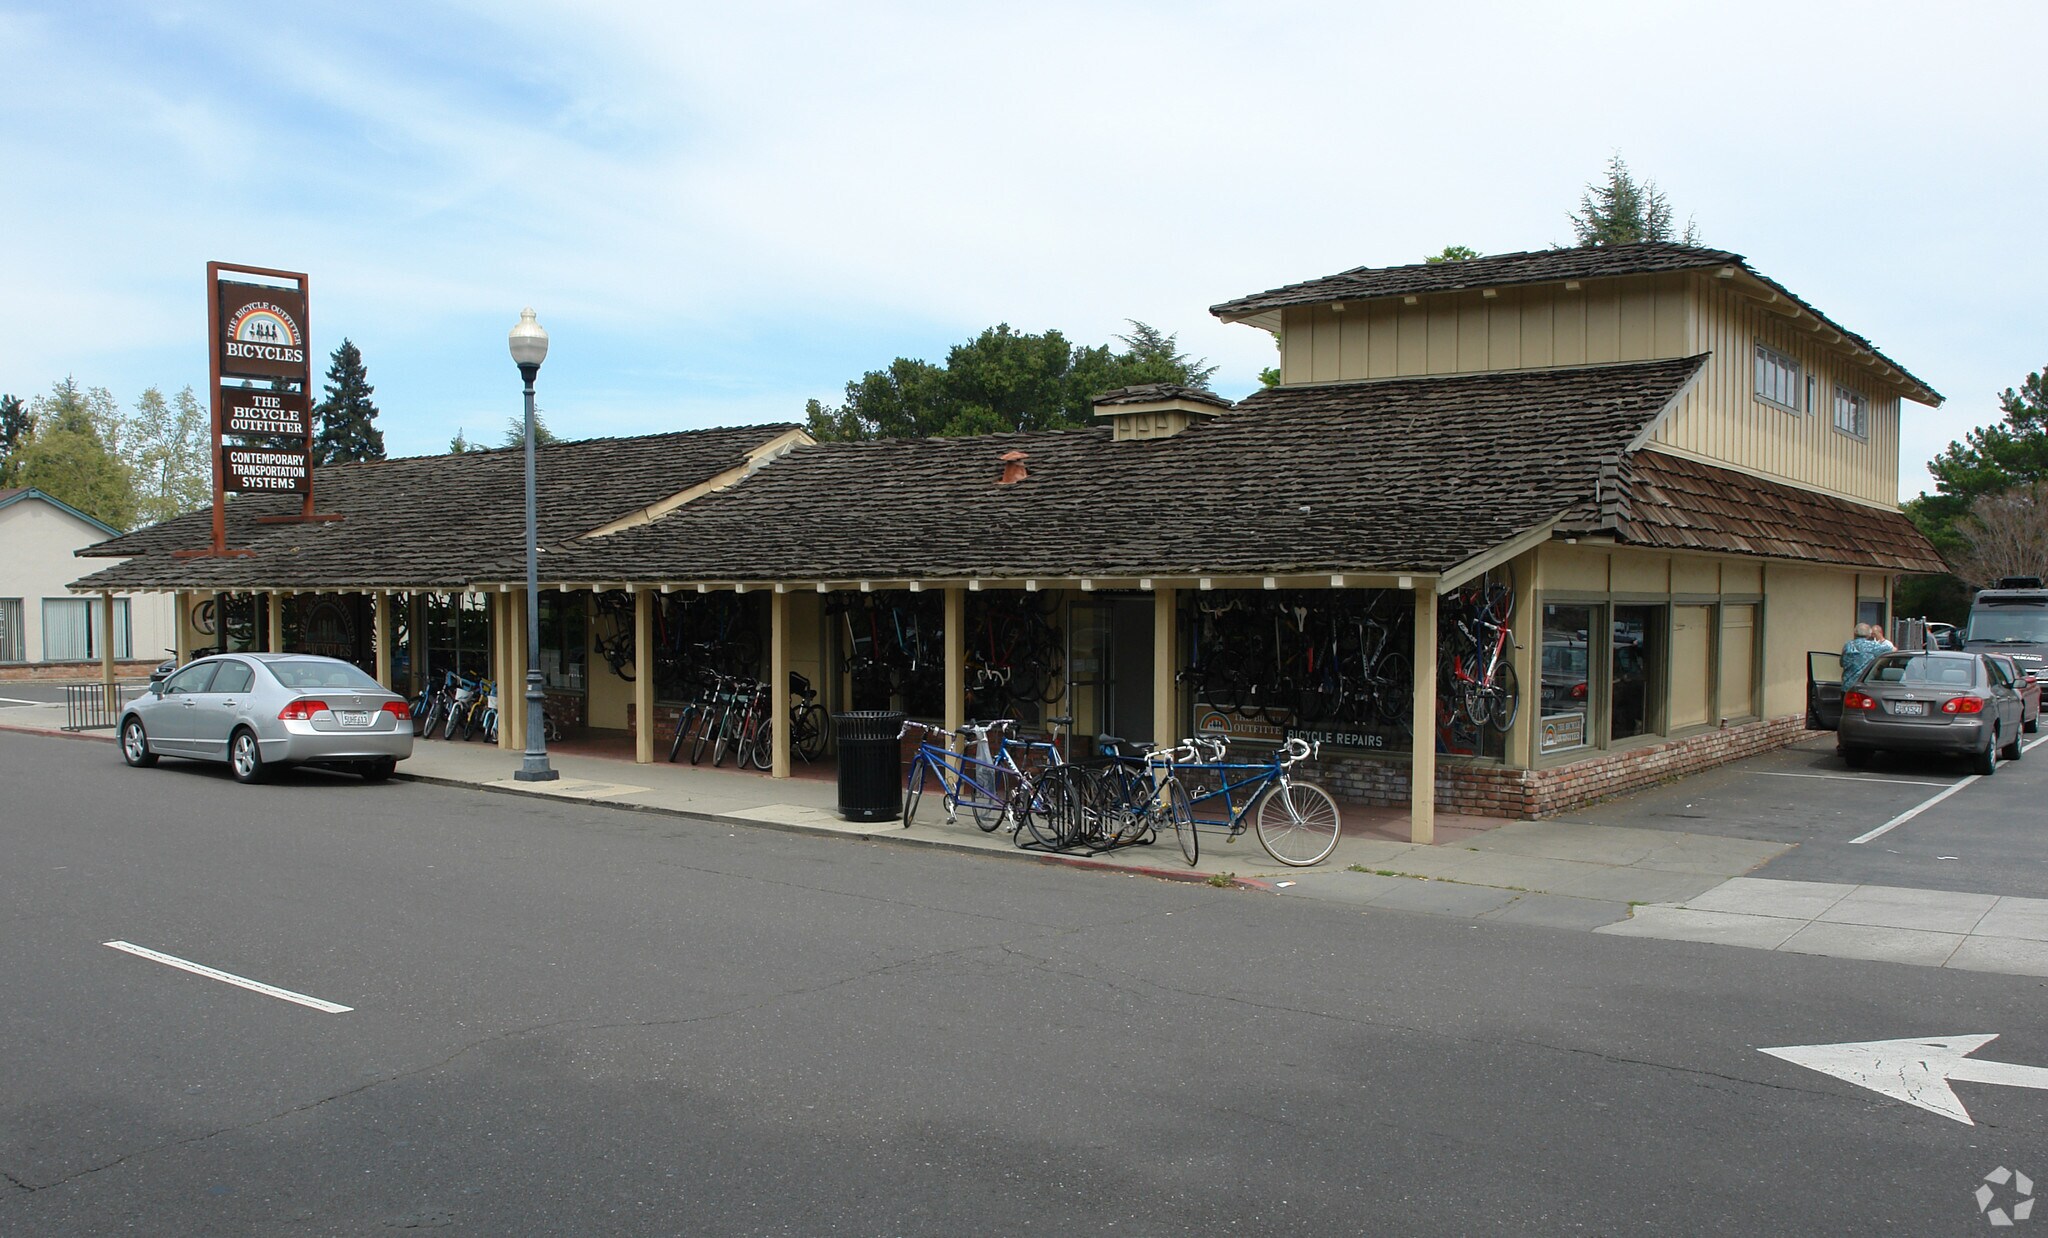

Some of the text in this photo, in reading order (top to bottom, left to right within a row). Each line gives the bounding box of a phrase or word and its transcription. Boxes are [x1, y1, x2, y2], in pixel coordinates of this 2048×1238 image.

[228, 302, 302, 345] THE BICYCLE OUTFITTER
[226, 342, 303, 363] BICYCLES
[253, 396, 280, 408] THE
[233, 406, 299, 421] BICYCLE
[231, 419, 303, 433] OUTFITTER
[230, 451, 305, 466] CONTEMPORARY
[232, 464, 305, 477] TRANSPORTATION
[242, 477, 295, 489] SYSTEMS
[1234, 723, 1283, 735] OUTFITTE
[1288, 729, 1383, 747] BICYCLE REPAIRS
